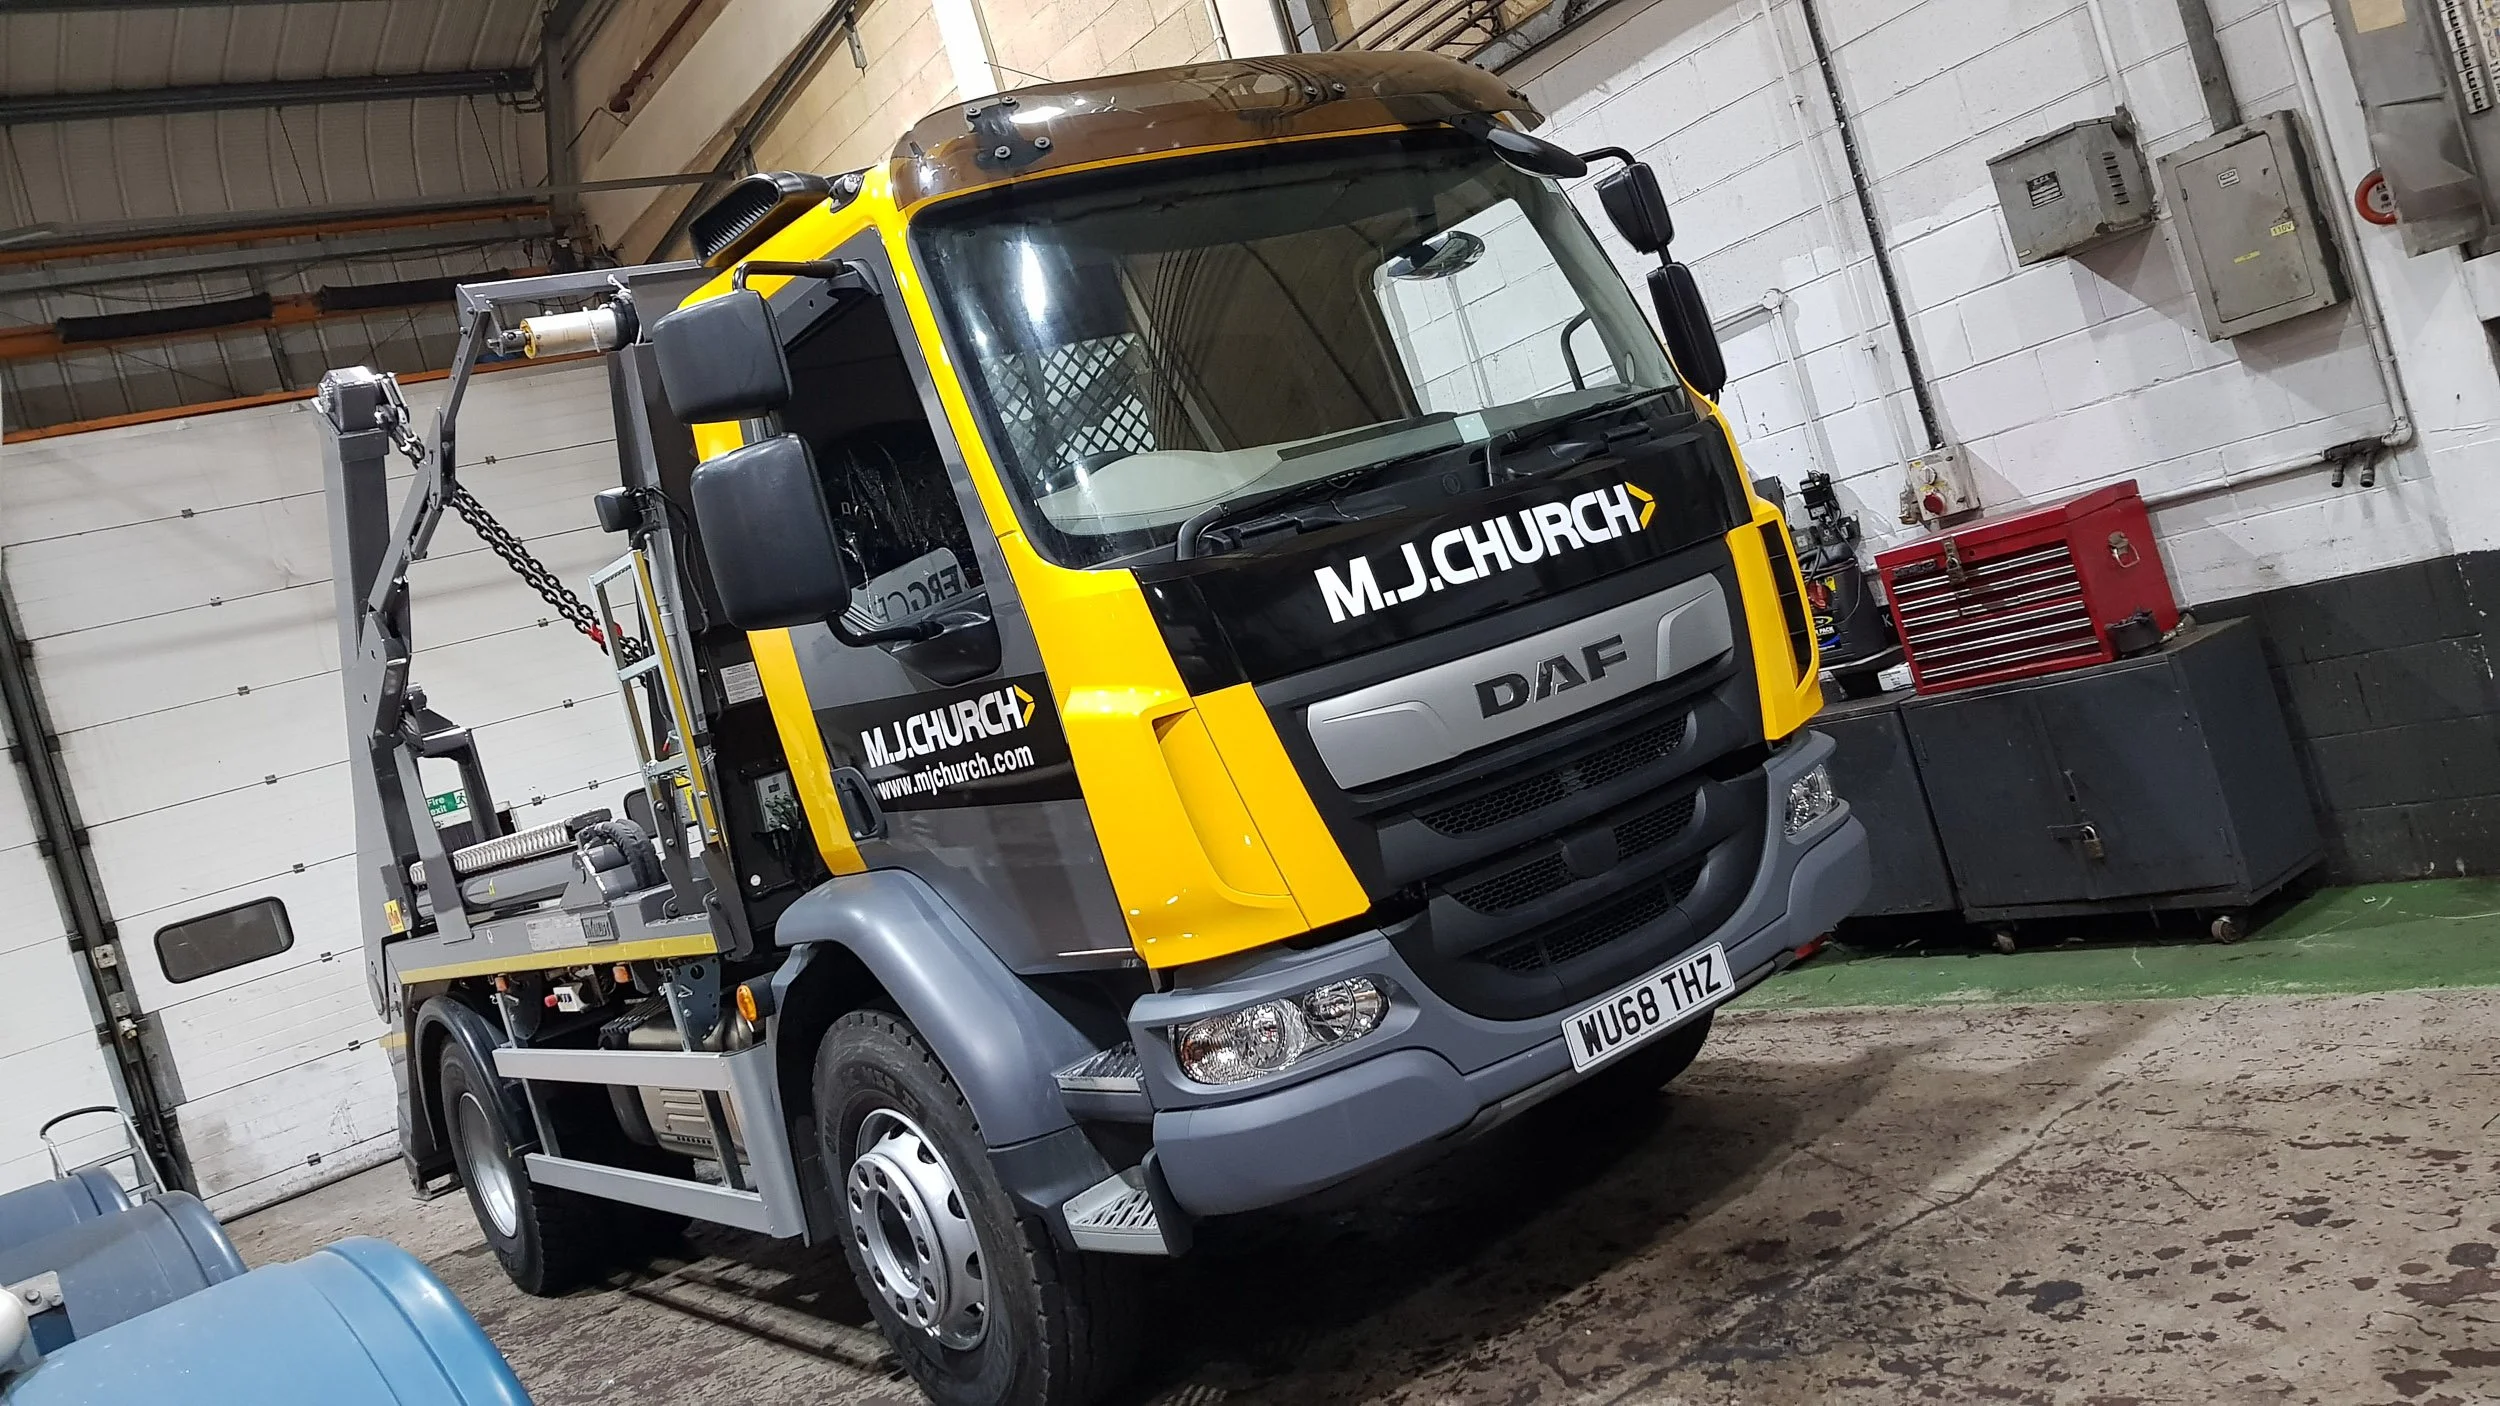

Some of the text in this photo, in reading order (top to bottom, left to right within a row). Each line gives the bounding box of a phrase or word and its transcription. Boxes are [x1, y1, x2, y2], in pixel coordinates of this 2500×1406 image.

[2272, 222, 2292, 235] 110V
[1313, 483, 1642, 624] M.J.CHURCH
[1472, 633, 1630, 720] DAF
[860, 686, 1025, 769] M.J.CHURCH
[427, 796, 445, 807] Fire
[877, 745, 1035, 800] www.mjchurch.com
[430, 805, 448, 816] exit
[1577, 953, 1722, 1057] WU68 THZ
